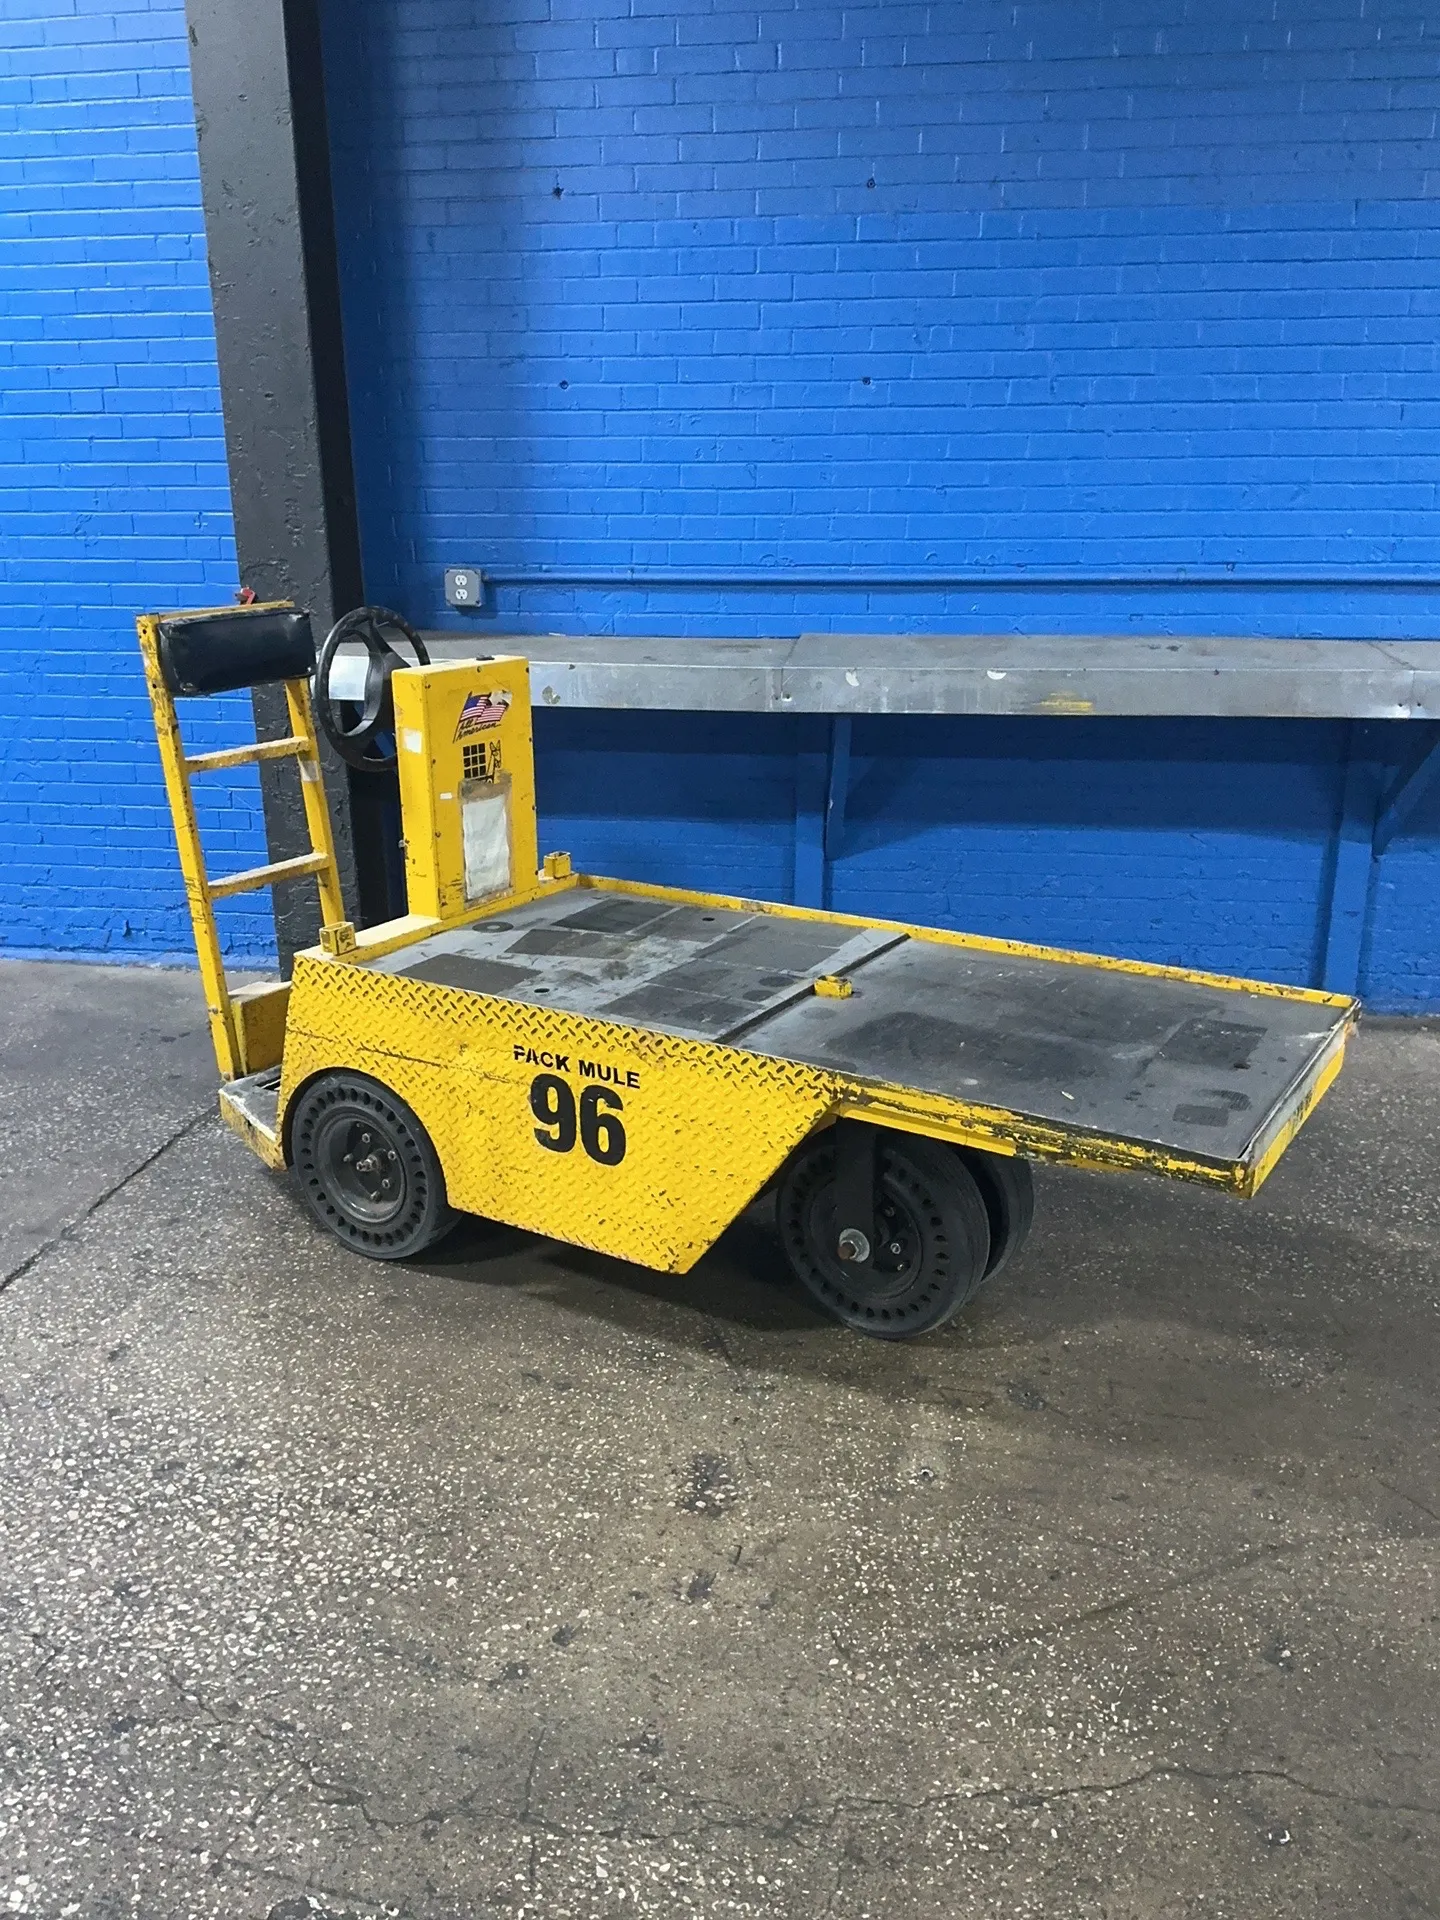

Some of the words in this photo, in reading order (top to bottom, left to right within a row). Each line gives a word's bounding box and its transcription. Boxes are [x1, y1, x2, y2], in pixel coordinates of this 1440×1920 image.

[459, 718, 475, 730] All
[513, 1044, 571, 1073] PACK
[578, 1059, 641, 1089] MULE
[530, 1073, 626, 1167] 96
